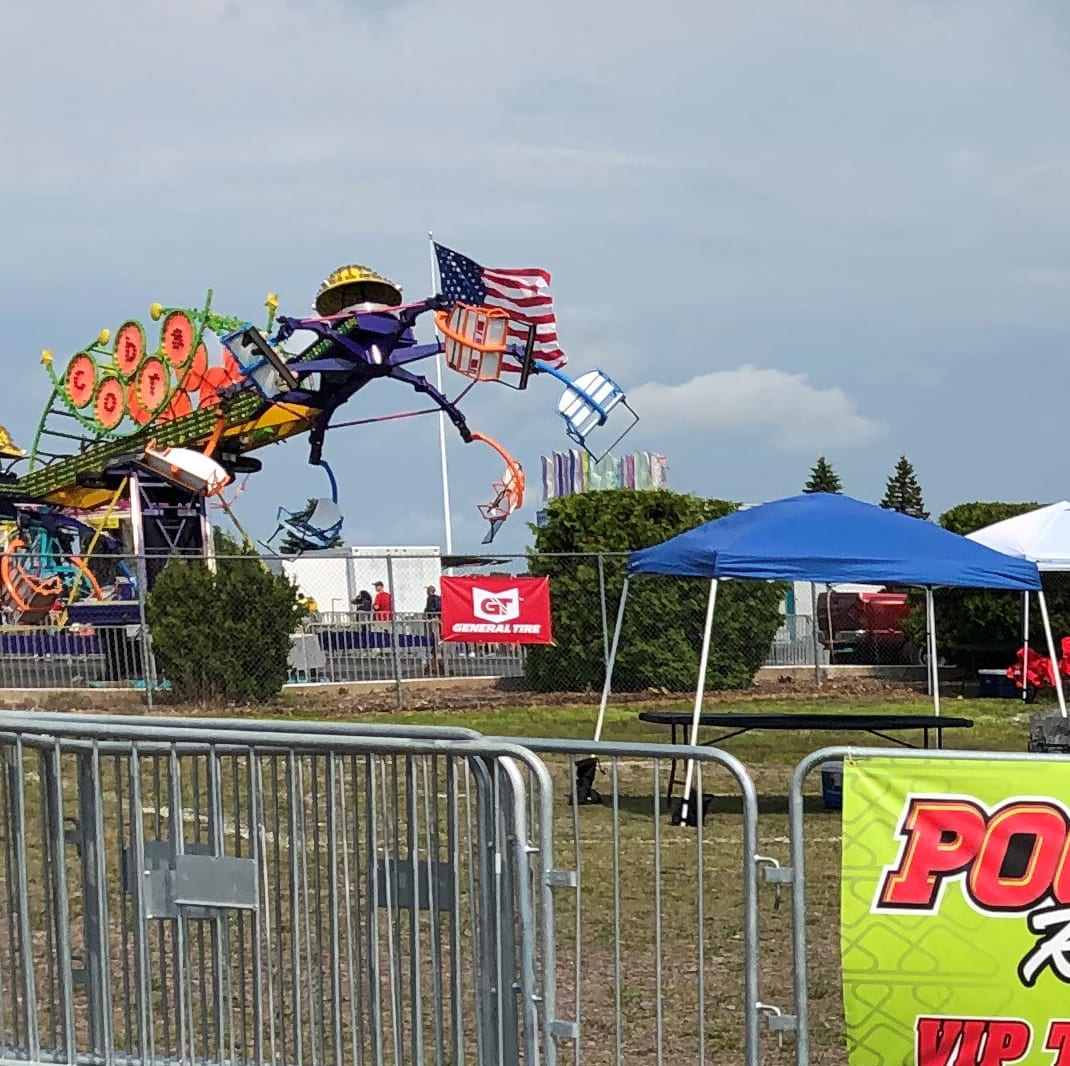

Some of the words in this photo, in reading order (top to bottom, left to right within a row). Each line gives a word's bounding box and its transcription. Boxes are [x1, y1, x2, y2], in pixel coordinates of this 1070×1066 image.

[480, 597, 513, 616] GT
[452, 622, 511, 634] GENERAL
[512, 623, 542, 634] TIRE
